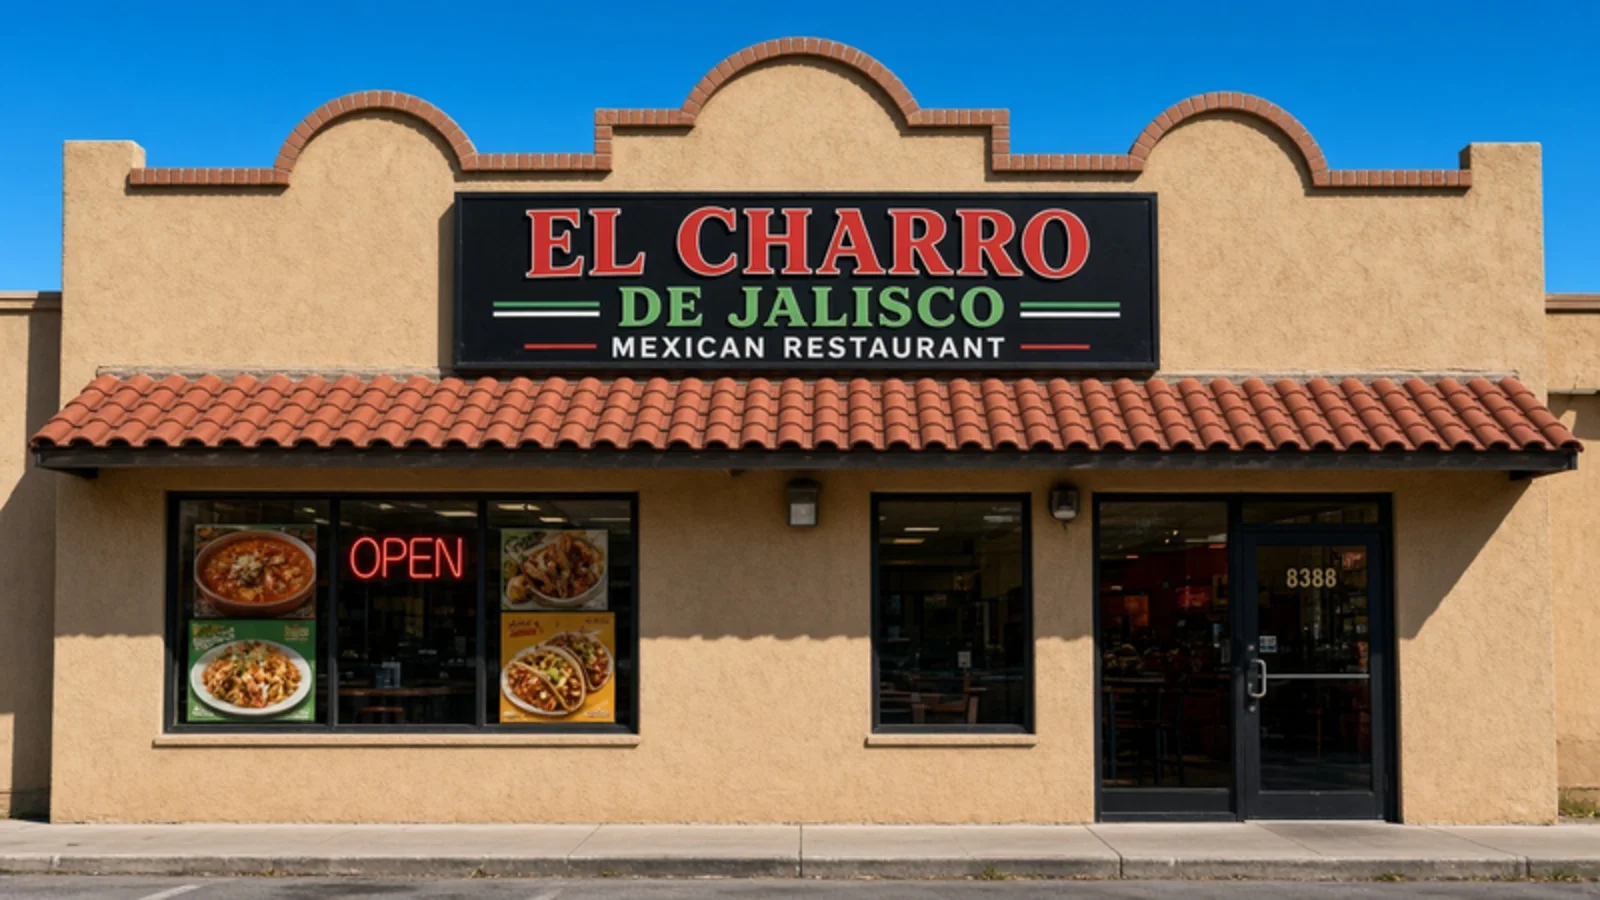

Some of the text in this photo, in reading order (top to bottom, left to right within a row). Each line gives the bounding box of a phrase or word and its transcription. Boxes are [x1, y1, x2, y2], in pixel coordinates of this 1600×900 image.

[525, 205, 1091, 279] EL CHARRO
[618, 285, 1005, 328] DE JALISCO
[612, 336, 1006, 359] MEXICAN RESTAURANT
[349, 536, 464, 580] OPEN
[1286, 567, 1337, 588] 8388
